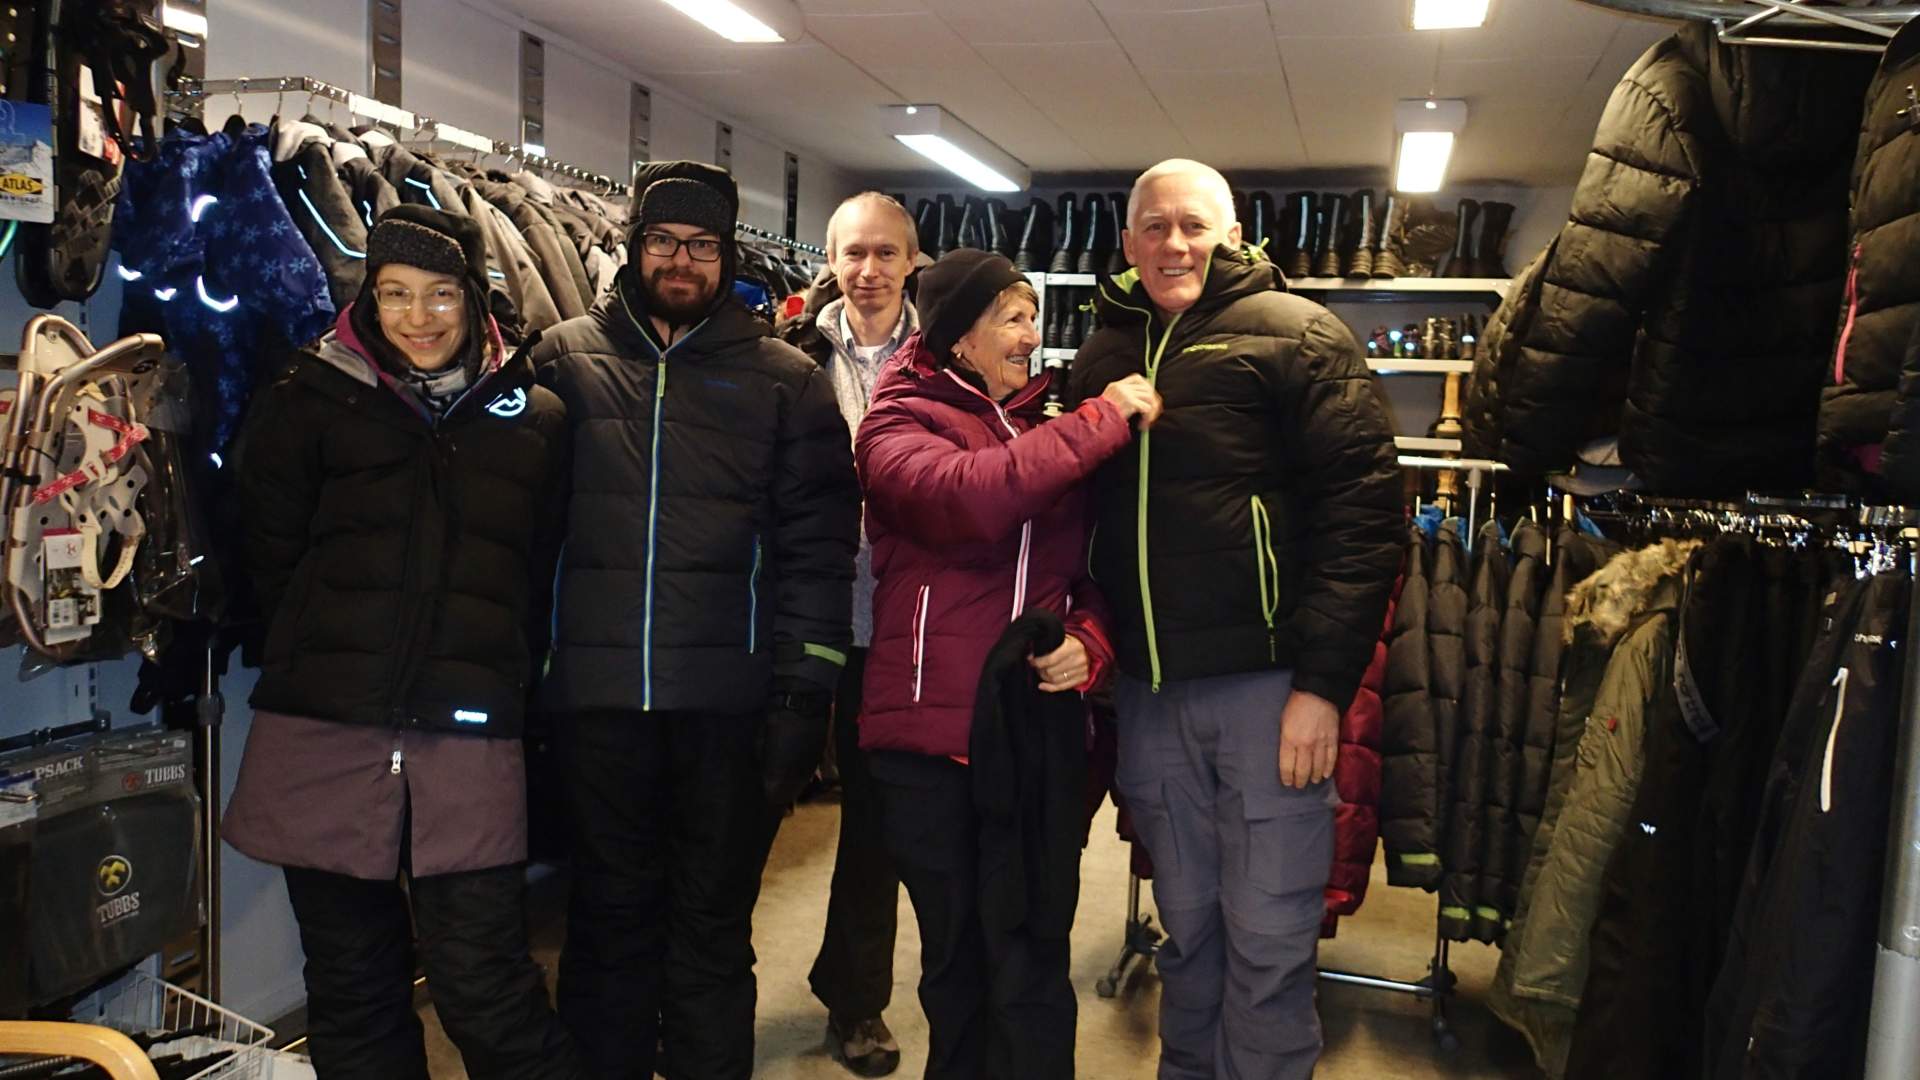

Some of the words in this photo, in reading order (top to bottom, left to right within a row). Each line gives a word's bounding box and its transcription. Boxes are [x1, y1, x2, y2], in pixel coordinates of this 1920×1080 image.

[3, 177, 33, 191] ATLAS
[13, 756, 84, 780] PSACK
[145, 764, 185, 785] TUBBS
[96, 892, 140, 923] TUBBS
